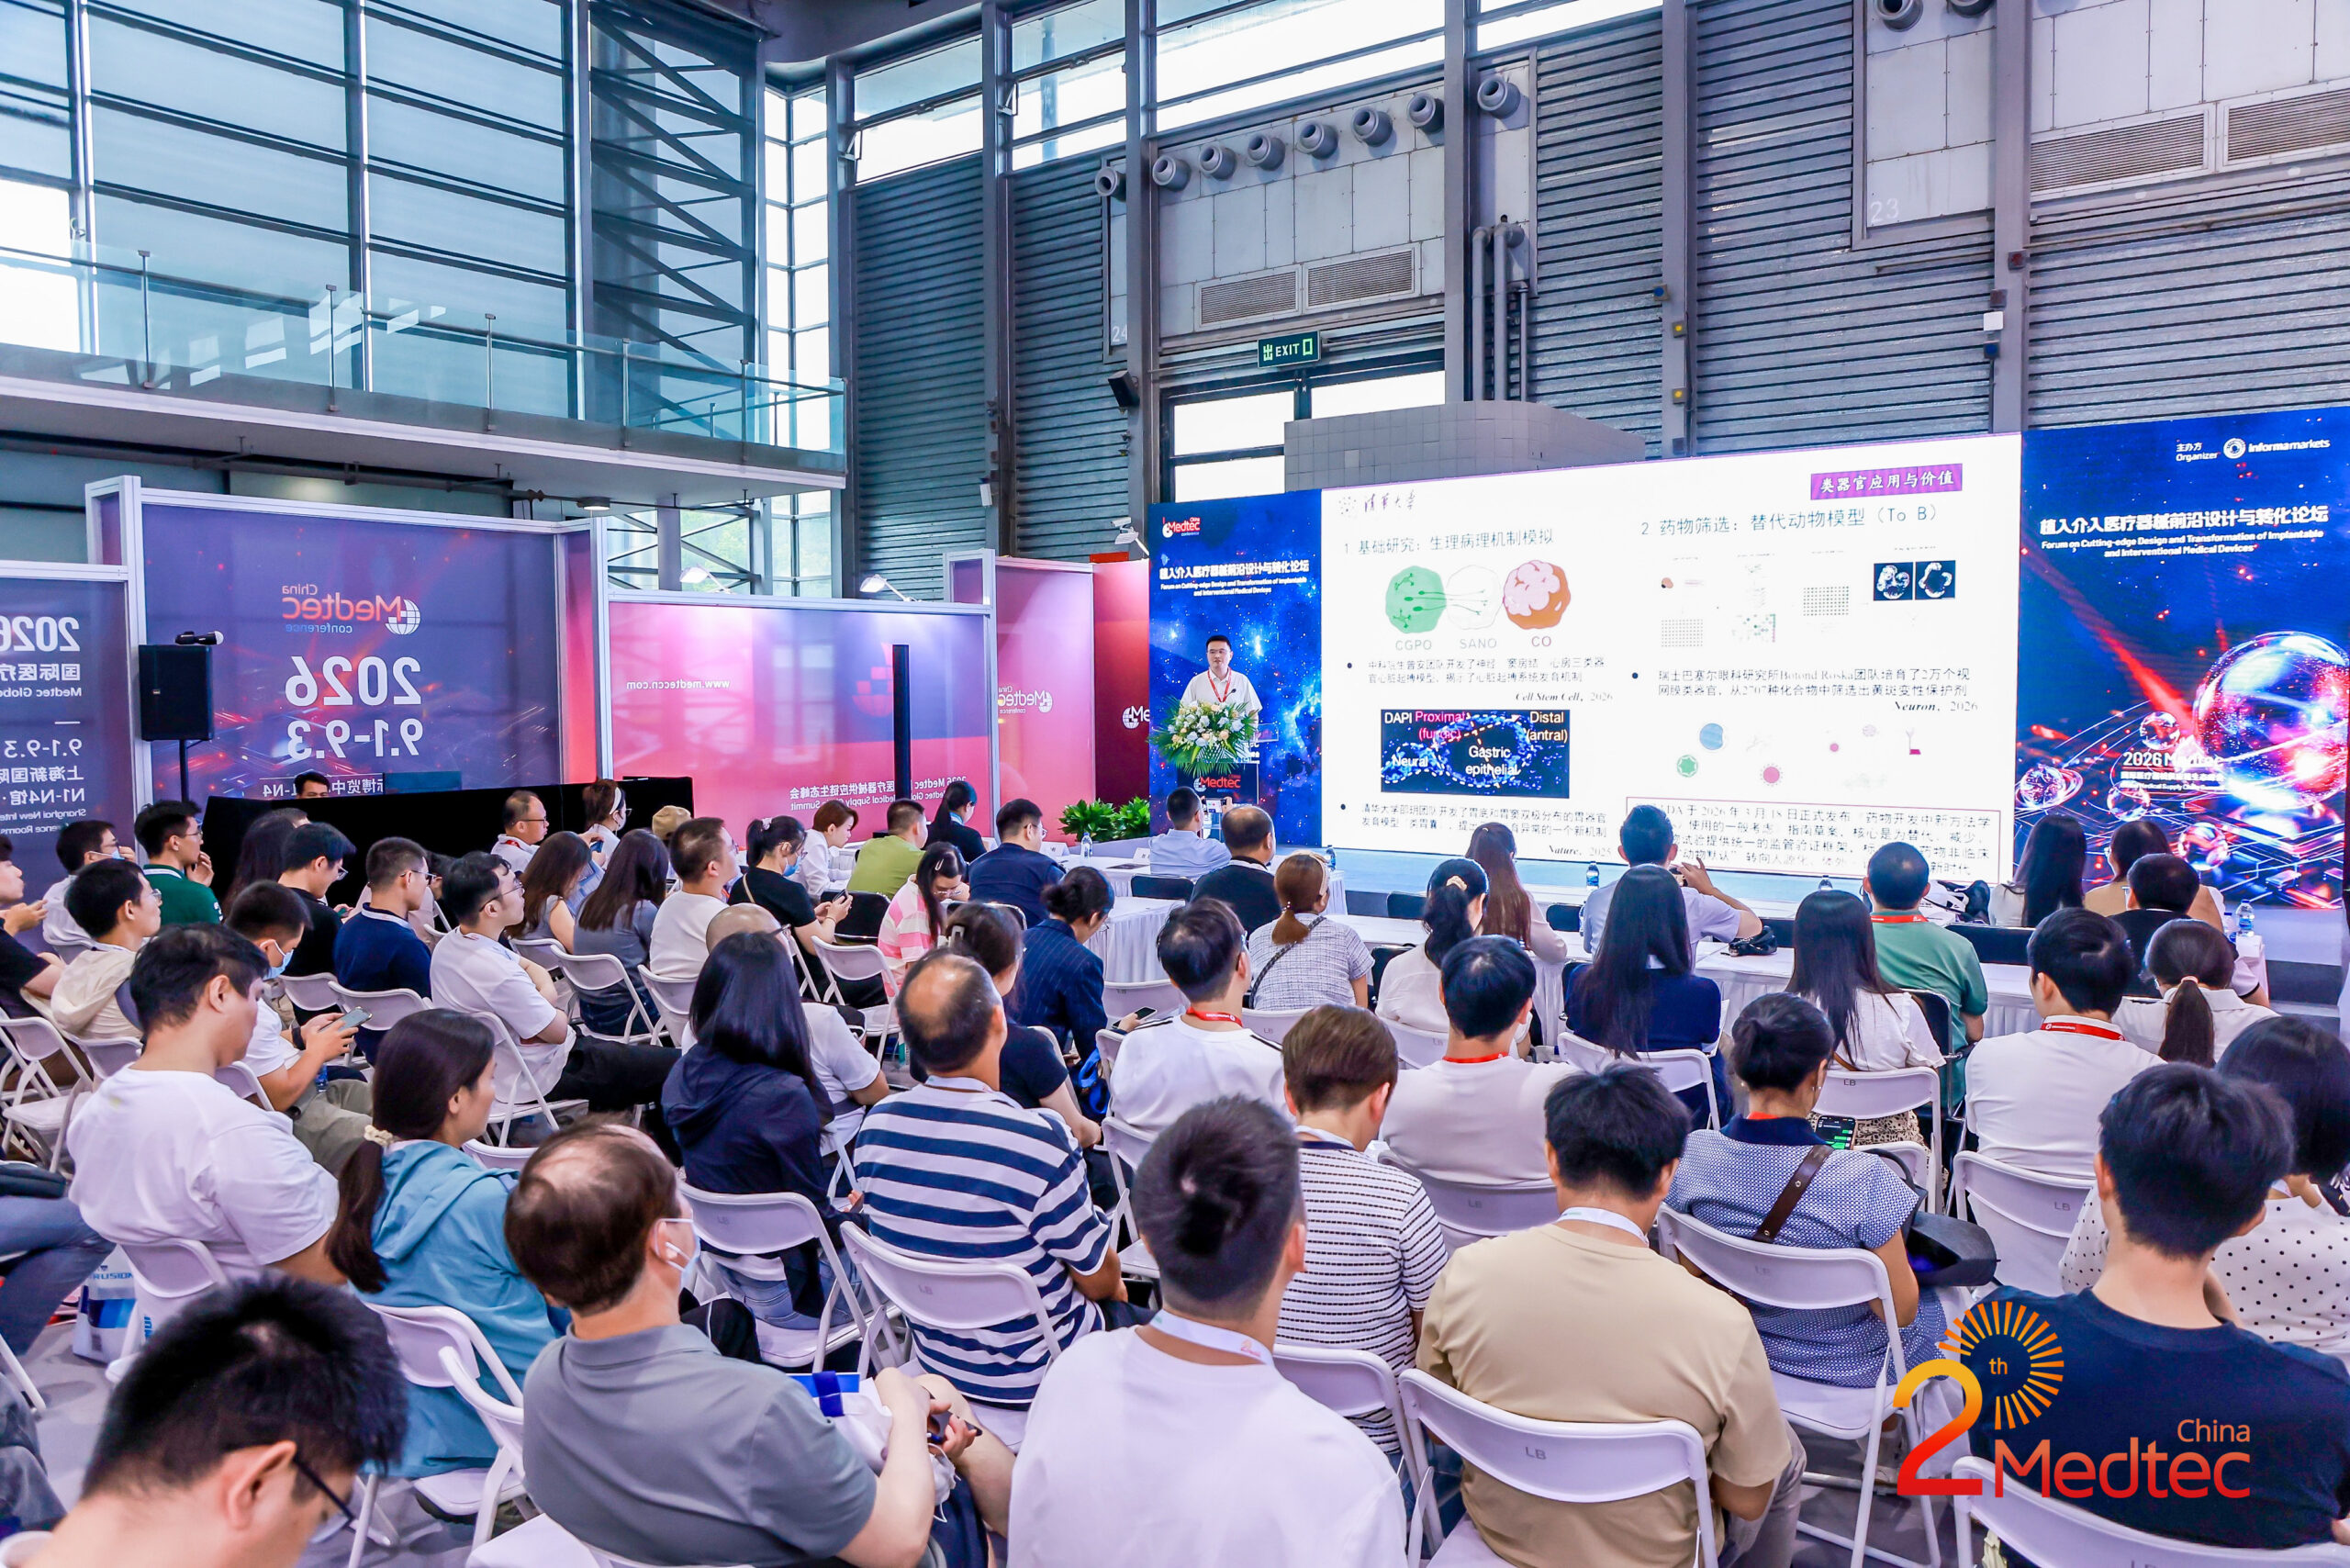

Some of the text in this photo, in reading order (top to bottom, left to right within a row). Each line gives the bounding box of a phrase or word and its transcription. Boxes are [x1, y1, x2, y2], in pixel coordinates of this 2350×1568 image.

[1870, 198, 1899, 224] 23
[1263, 343, 1273, 362] 出
[1275, 343, 1300, 357] EXIT
[2176, 452, 2218, 462] Organizer
[1820, 470, 1954, 493] 类器官应用与价值
[1169, 521, 1201, 532] Medtec
[1641, 522, 1649, 535] 2
[2042, 528, 2324, 550] Forum on Cutting-edge Design and Transformation of Implantable
[2104, 543, 2255, 558] and Interventional Medical Devices
[1395, 635, 1551, 651] CGPO SANO CO
[1384, 712, 1412, 723] DAPI
[1529, 711, 1564, 722] Distal
[1468, 745, 1511, 758] Gastric
[1392, 755, 1428, 767] Neural
[2122, 751, 2162, 767] 2026
[1199, 776, 1241, 789] Medtec
[1754, 807, 1765, 819] 月
[1468, 1200, 1483, 1209] LB
[2053, 1201, 2071, 1211] LB
[1525, 1447, 1547, 1461] LB
